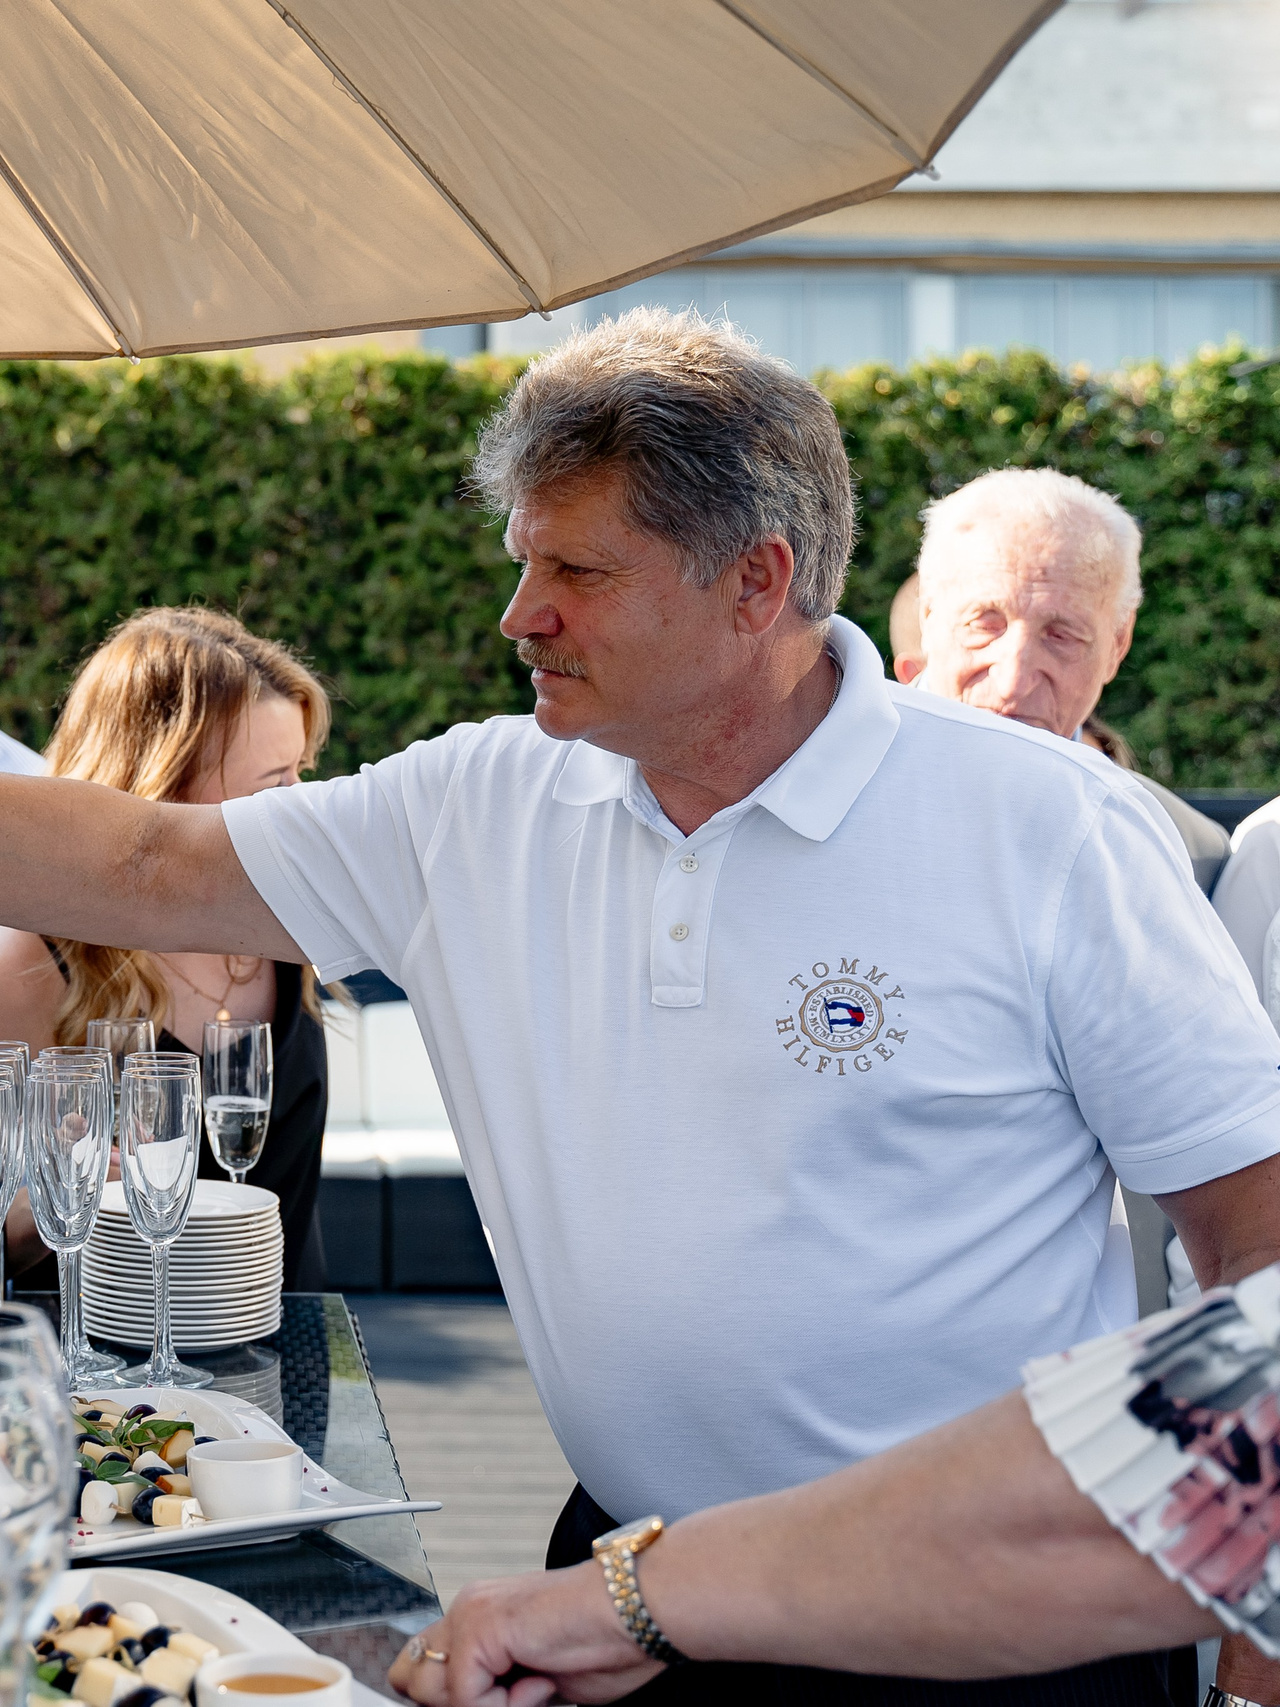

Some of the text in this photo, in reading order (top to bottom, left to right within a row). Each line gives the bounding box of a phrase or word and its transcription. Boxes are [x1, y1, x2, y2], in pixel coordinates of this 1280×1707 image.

[788, 957, 905, 1000] TOMMY
[809, 986, 874, 1018] ESTABLISHED
[776, 1015, 908, 1076] HILFIGER
